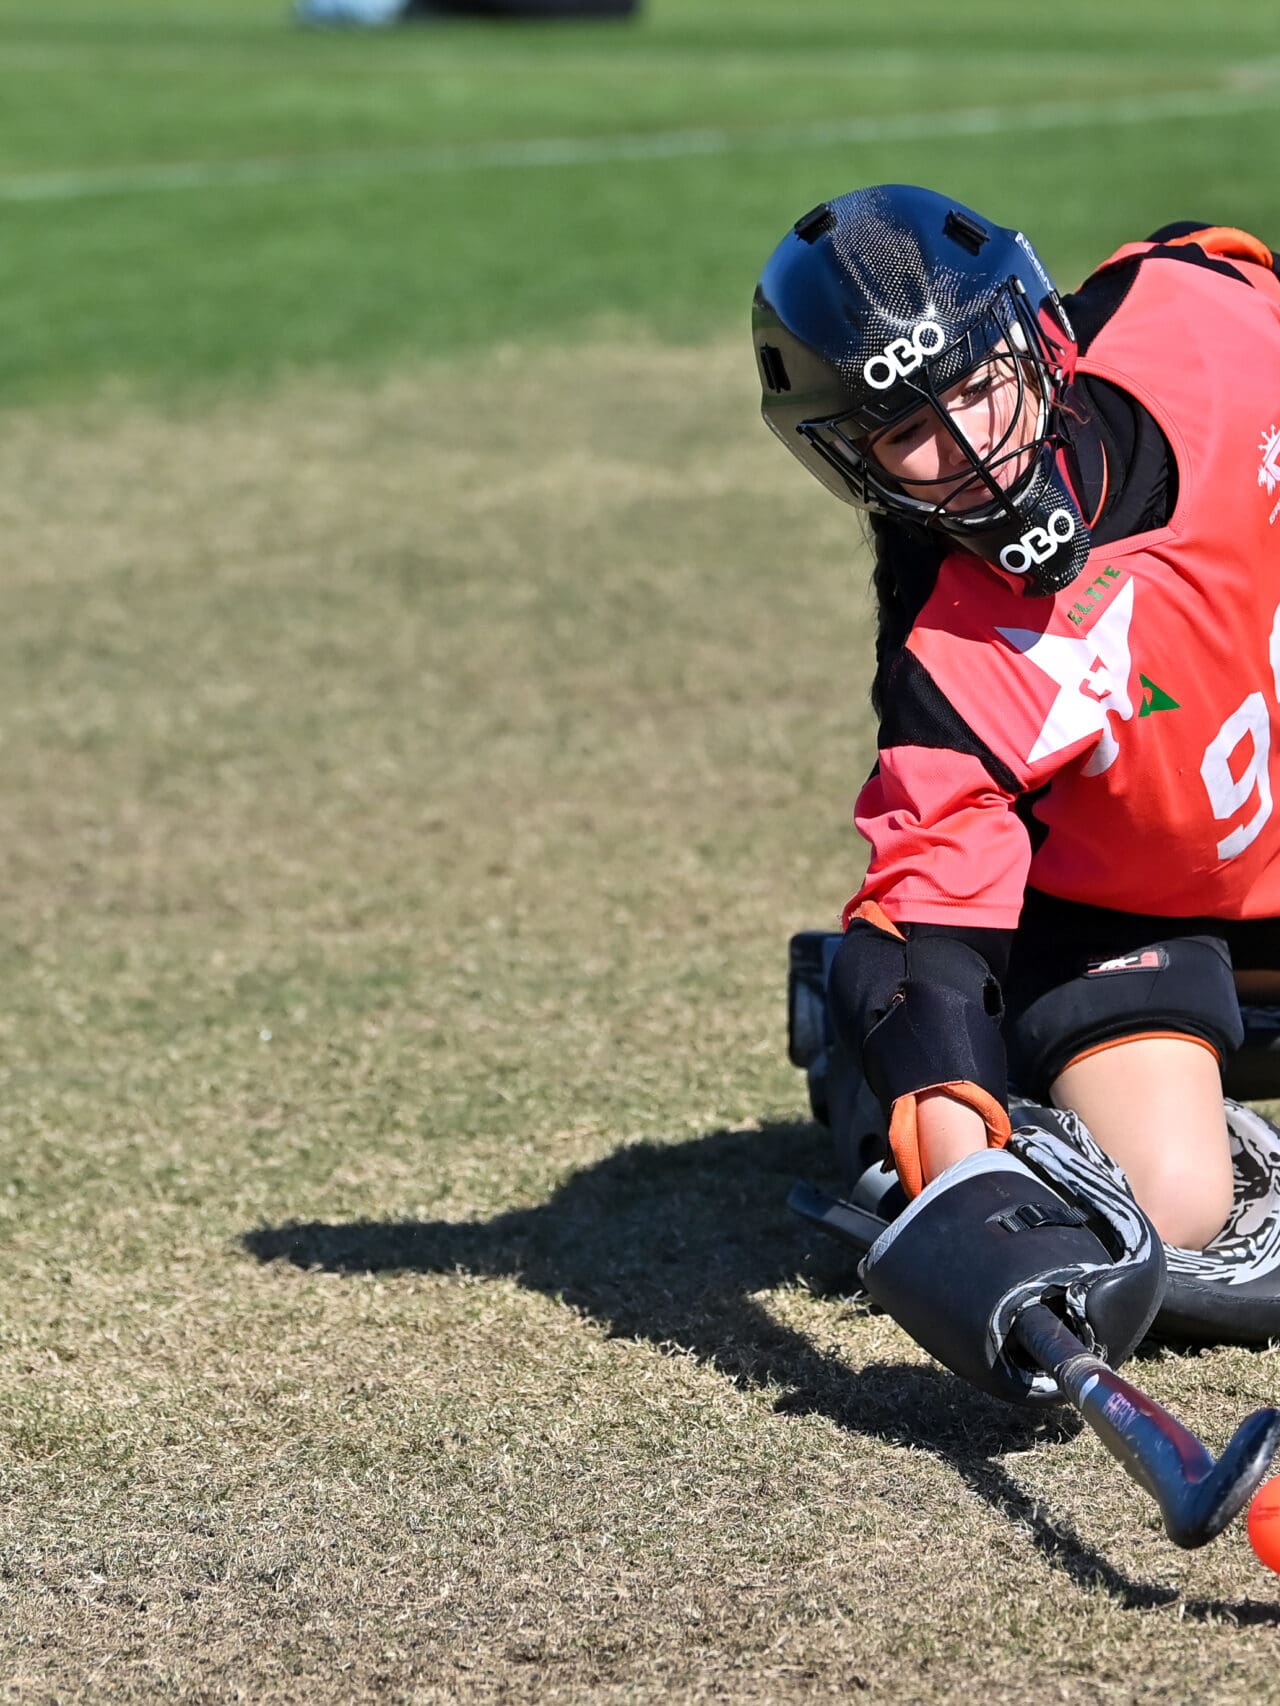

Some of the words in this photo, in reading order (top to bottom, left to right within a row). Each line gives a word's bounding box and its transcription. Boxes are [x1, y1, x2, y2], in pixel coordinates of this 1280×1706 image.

[864, 320, 945, 390] OBO
[999, 508, 1075, 574] OBO
[1067, 565, 1121, 625] ELITE
